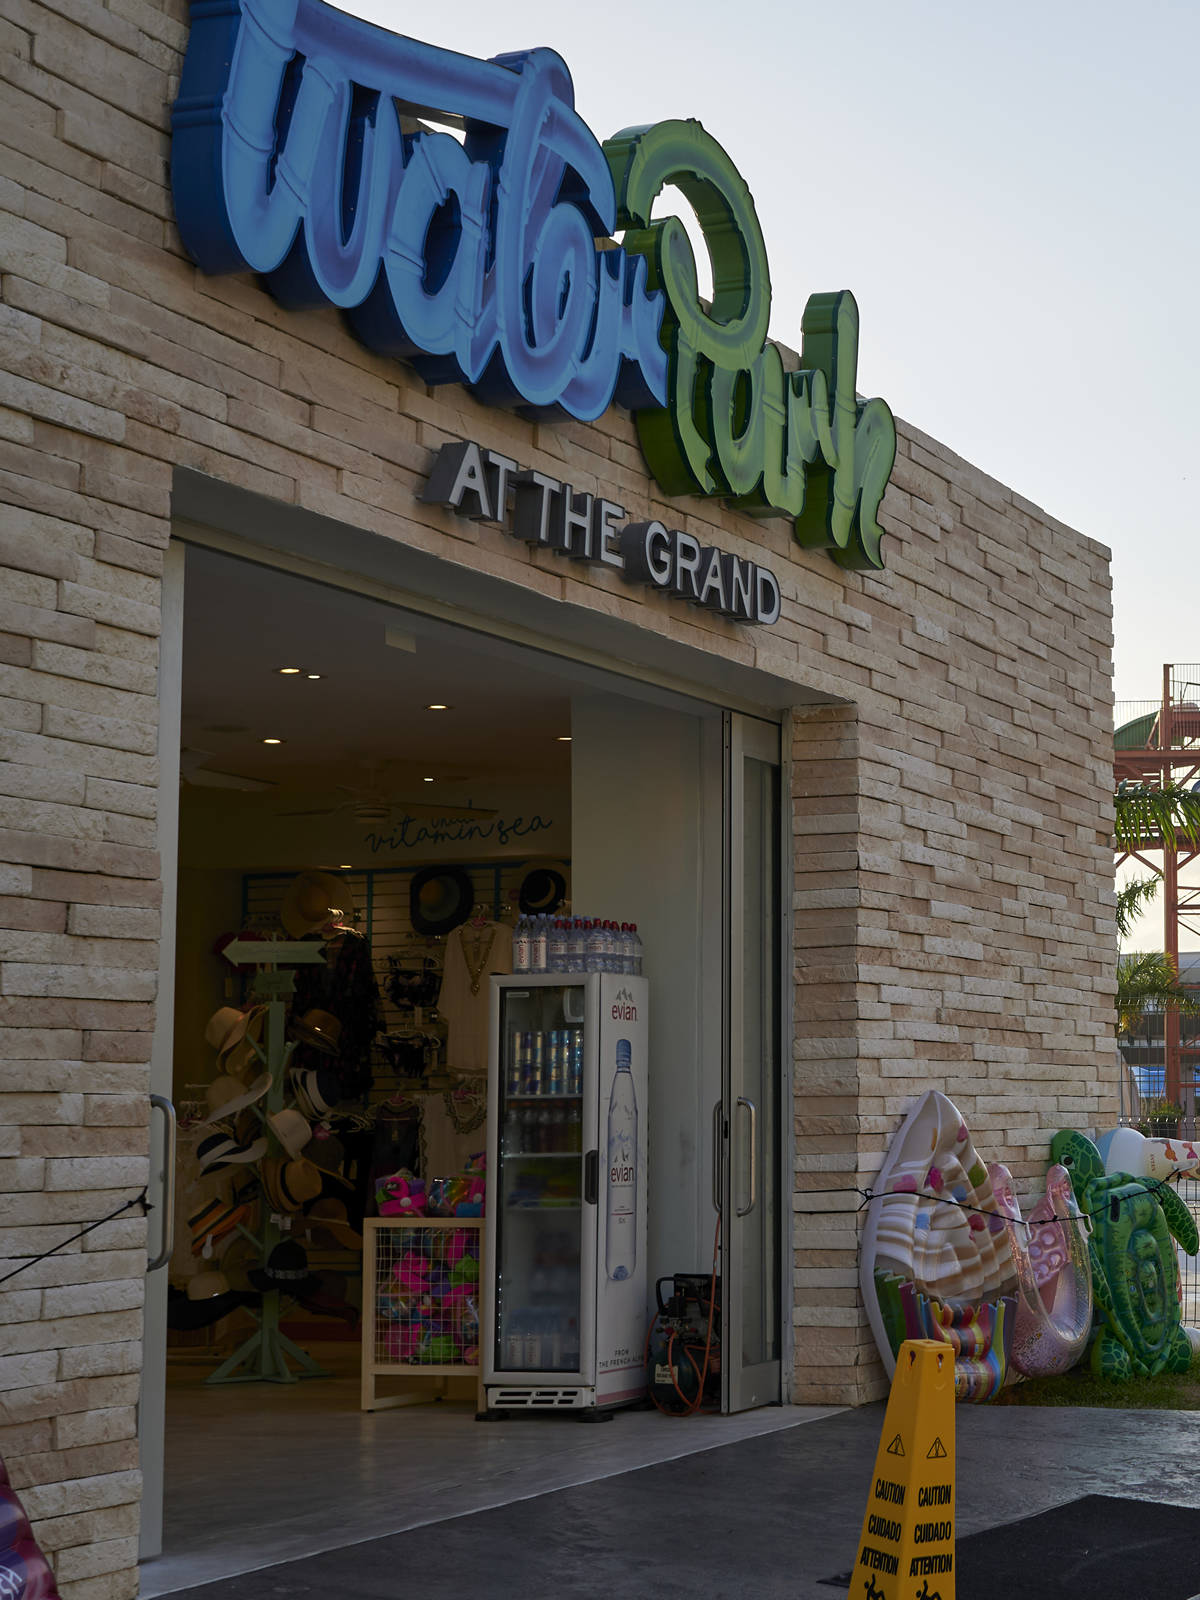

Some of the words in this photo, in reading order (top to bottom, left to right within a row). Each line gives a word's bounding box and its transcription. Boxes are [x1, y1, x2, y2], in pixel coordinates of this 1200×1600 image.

[438, 440, 519, 522] AT
[527, 470, 626, 570] THE
[634, 520, 782, 626] GRAND
[365, 815, 495, 853] vitamin
[497, 815, 554, 845] sea
[612, 1003, 638, 1021] evian
[611, 1164, 635, 1183] evian
[610, 1357, 631, 1367] FRENCH
[615, 1349, 629, 1357] FROM
[875, 1478, 906, 1506] CAUTION
[918, 1484, 952, 1507] CAUTION
[868, 1514, 902, 1543] CUIDADO
[914, 1521, 951, 1544] CUIDADO
[860, 1546, 899, 1576] ATTENTION
[909, 1553, 953, 1577] ATTENTION
